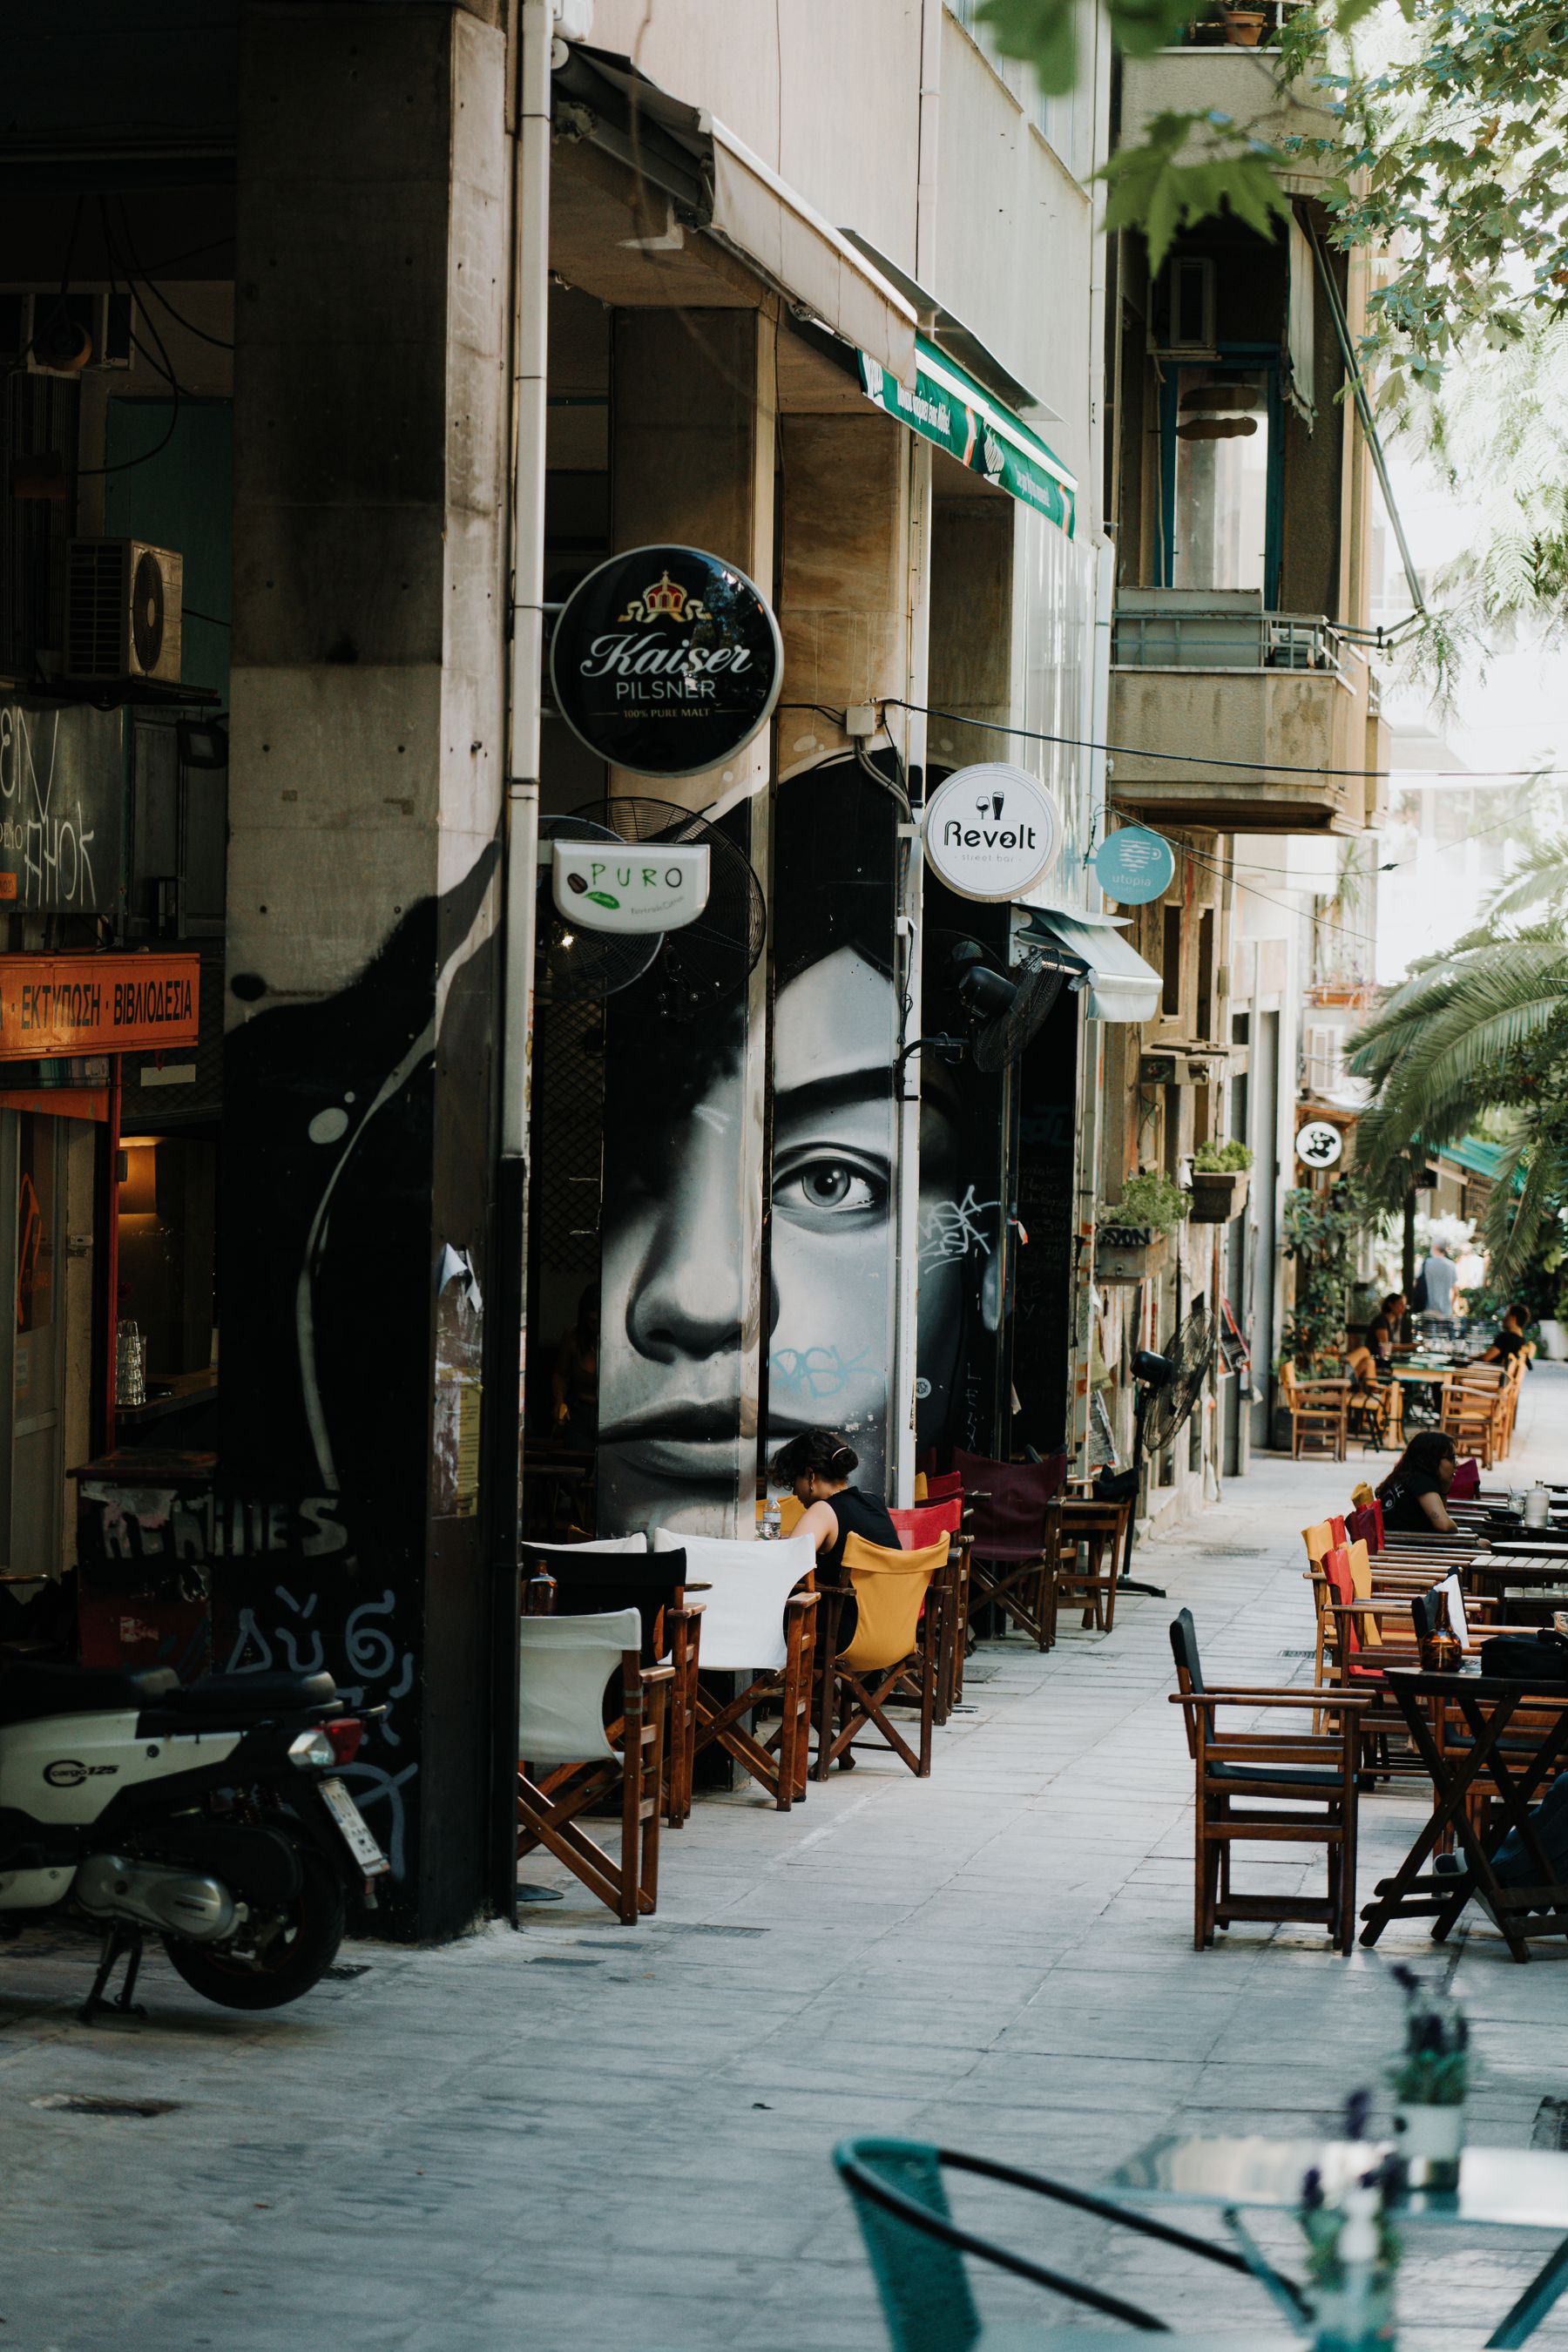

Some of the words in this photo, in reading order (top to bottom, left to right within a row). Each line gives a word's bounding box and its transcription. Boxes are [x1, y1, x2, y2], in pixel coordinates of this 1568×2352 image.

[579, 632, 754, 678] Kaiser
[616, 679, 717, 700] PILSNER
[623, 709, 649, 719] 100%
[652, 708, 679, 718] PURE
[681, 707, 711, 717] MALT
[961, 854, 992, 862] street
[997, 854, 1014, 863] bar
[591, 862, 682, 889] PURO
[1112, 874, 1152, 888] utopia
[21, 983, 101, 1031] ΕΚΤΥΠΩΣΗ
[113, 979, 193, 1026] ΒΙΒΛΙΟΔΕΣΙΑ
[87, 1764, 119, 1776] 125
